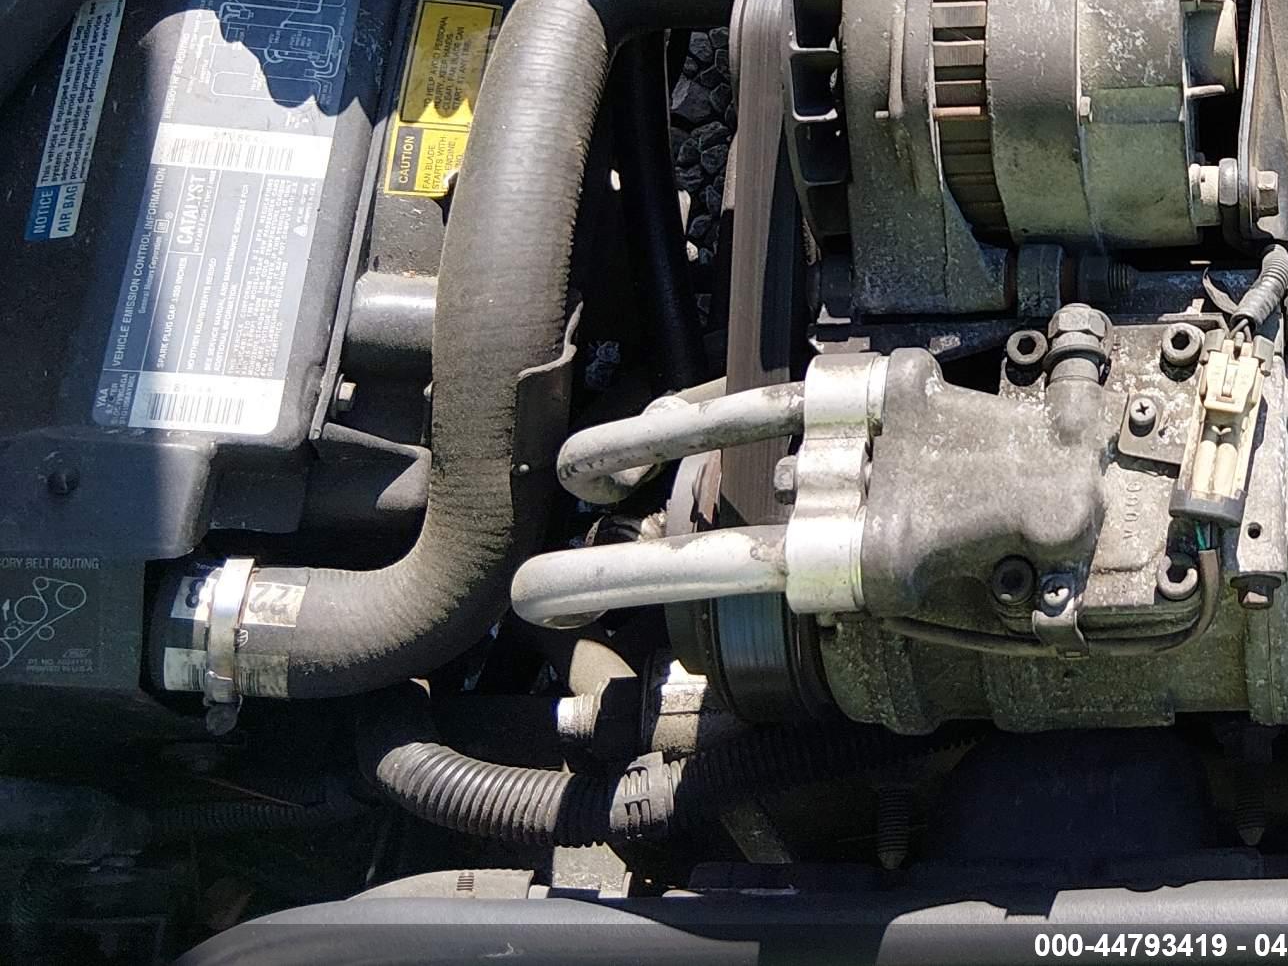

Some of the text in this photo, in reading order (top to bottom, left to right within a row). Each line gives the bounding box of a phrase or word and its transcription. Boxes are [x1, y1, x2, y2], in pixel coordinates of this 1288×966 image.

[73, 26, 84, 39] bag
[90, 15, 103, 42] service
[433, 16, 448, 49] PERSONAL
[455, 26, 464, 40] CAN
[86, 45, 96, 59] and
[97, 44, 107, 56] any
[442, 33, 453, 56] HANDS
[450, 42, 461, 64] BLADE
[64, 66, 74, 81] with
[429, 53, 440, 73] AVOID
[439, 60, 448, 77] KEEP
[447, 67, 457, 80] FAN
[76, 63, 93, 102] diagnostic
[85, 59, 103, 101] performing
[425, 76, 436, 95] HELP
[452, 87, 462, 109] START
[458, 58, 467, 72] ANY
[55, 84, 71, 121] equipped
[65, 93, 76, 115] avoid
[61, 119, 72, 134] help
[79, 105, 92, 130] before
[58, 138, 66, 146] To
[67, 120, 79, 148] manual
[45, 134, 58, 162] vehicle
[69, 133, 86, 178] procedures
[397, 135, 415, 183] CAUTION
[40, 165, 51, 181] This
[60, 151, 72, 179] service
[422, 144, 435, 188] FAN BLADE
[431, 136, 446, 189] STARTS WITH
[33, 190, 53, 233] NOTICE
[57, 185, 78, 230] AIR BAG
[175, 175, 207, 243] CATALYST
[112, 325, 130, 365] VEHICLE
[122, 278, 141, 322] EMISSION
[133, 232, 151, 275] CONTROL
[144, 166, 167, 228] INFORMATION
[137, 235, 163, 312] General Motors Corporation
[174, 257, 188, 283] INCHES
[166, 304, 177, 319] GAP
[162, 321, 174, 340] PLUG
[156, 343, 169, 368] SPARK
[95, 387, 109, 407] YAA
[0, 557, 98, 568] ORY BELT ROUTING
